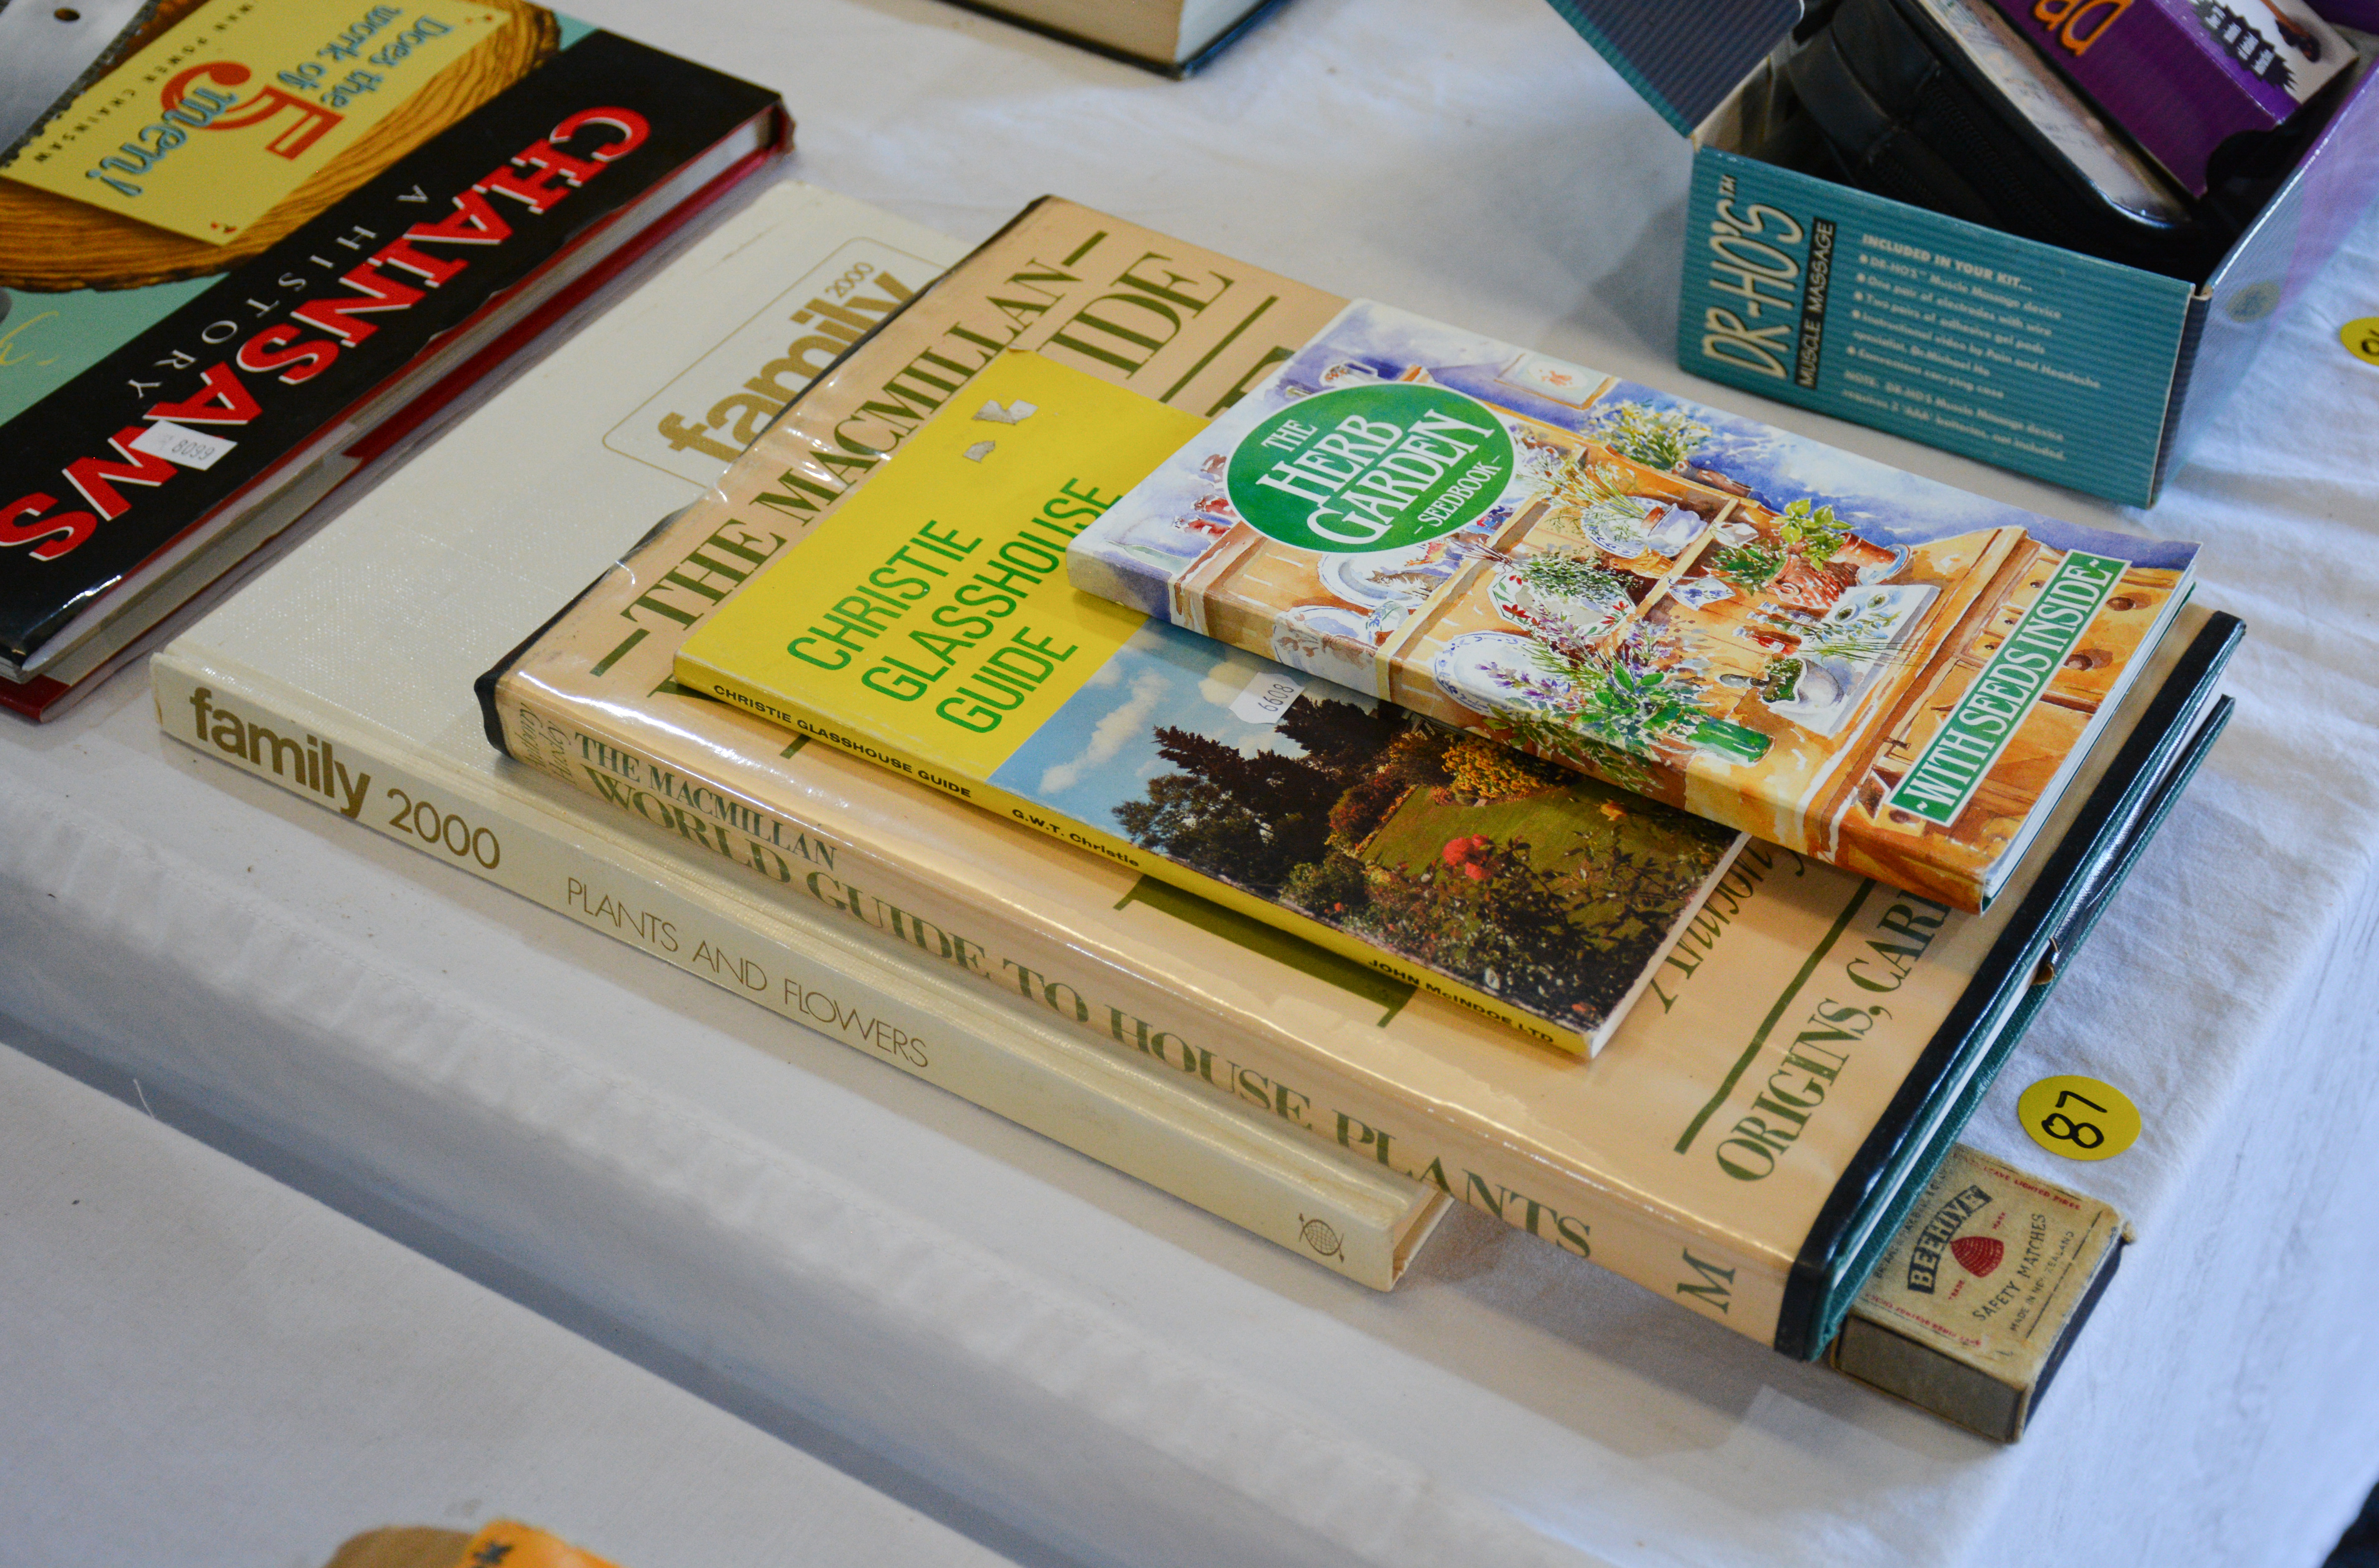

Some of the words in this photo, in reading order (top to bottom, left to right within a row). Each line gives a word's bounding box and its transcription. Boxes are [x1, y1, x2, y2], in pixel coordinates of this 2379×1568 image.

[278, 62, 326, 89] of
[317, 4, 404, 61] work
[369, 15, 456, 67] Does
[85, 87, 239, 197] men!
[161, 61, 344, 160] 5
[321, 69, 384, 108] the
[397, 185, 428, 202] A
[824, 262, 874, 298] 2000
[1807, 221, 1835, 313] MASSAGE
[1862, 233, 1931, 262] INCLUDED
[1934, 253, 1951, 268] IN
[1953, 259, 1994, 281] YOUR
[0, 106, 651, 561] CHAINSAWS
[127, 225, 376, 399] HISTORY
[1036, 253, 1235, 379] IDE
[1798, 320, 1821, 388] MUSCLE
[658, 271, 917, 463] family
[620, 518, 788, 631] THE
[749, 257, 1083, 527] MACMILLAN
[1255, 414, 1403, 502] HERB
[1260, 418, 1319, 453] THE
[1306, 408, 1496, 545] GARDEN
[1417, 462, 1502, 528] SEEDBOOK
[786, 519, 983, 671] CHRISTIE
[860, 477, 1124, 702] GLASSHOUSE
[935, 626, 1079, 734] GUIDE
[1258, 684, 1294, 712] 6608
[1903, 728, 1996, 807] WITH
[1959, 647, 2053, 736] SEEDS
[2019, 564, 2113, 654] INSIDE
[714, 684, 792, 724] CHRISTIE
[796, 718, 913, 774] GLASSHOUSE
[917, 769, 972, 799] GUIDE
[575, 732, 640, 783] THE
[647, 764, 838, 871] MACMILLAN
[1070, 832, 1139, 867] Christie
[190, 687, 371, 819] family
[387, 788, 500, 870] 2000
[568, 877, 678, 952] PLANTS
[692, 940, 767, 991] AND
[784, 978, 929, 1068] FLOWERS
[580, 763, 791, 883] WORLD
[806, 871, 991, 980] GUIDE
[1002, 957, 1090, 1023] TO
[1104, 1004, 1313, 1130] HOUSE
[1332, 1109, 1591, 1259] PLANTS
[1676, 1248, 1736, 1315] M
[1369, 959, 1420, 986] JOHN
[1426, 982, 1513, 1024] McINDOE
[1519, 1023, 1554, 1043] LTD
[1716, 997, 1892, 1181] ORIGINS,
[2041, 1090, 2108, 1148] 87
[1908, 1186, 1992, 1294] BEEHIVE
[1972, 1280, 2021, 1321] SAFETY
[2017, 1214, 2046, 1278] MATCHES
